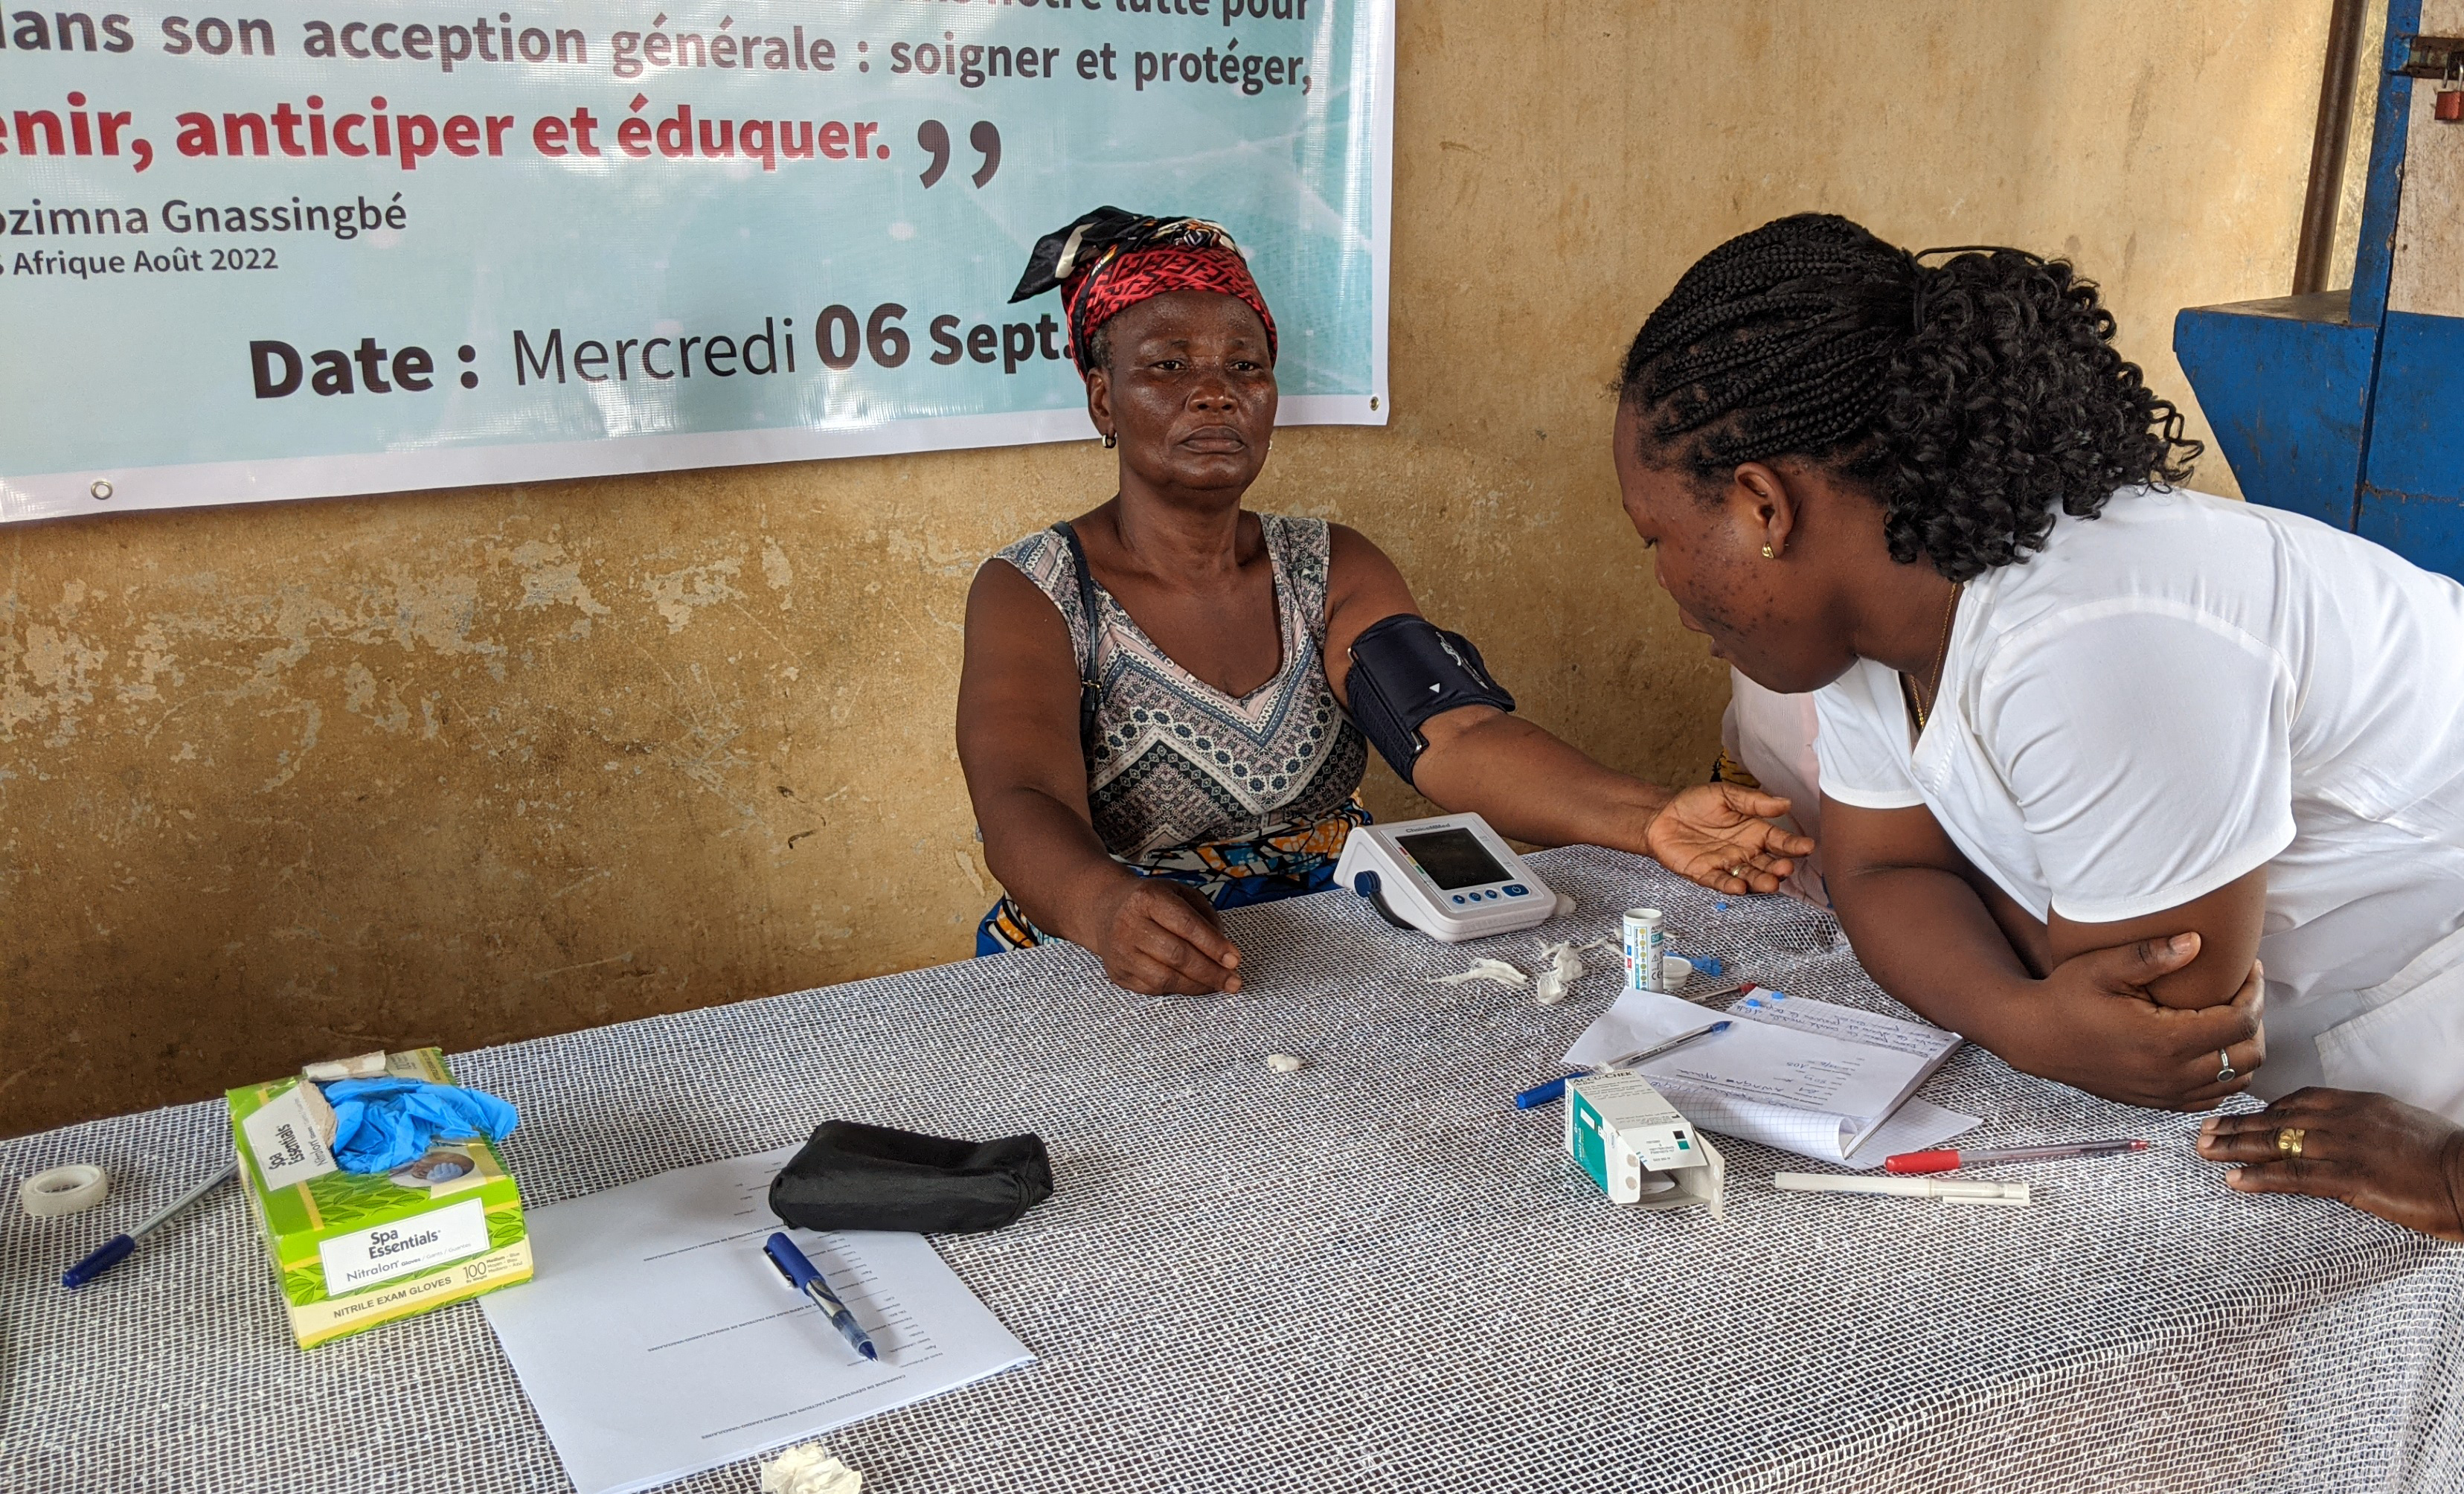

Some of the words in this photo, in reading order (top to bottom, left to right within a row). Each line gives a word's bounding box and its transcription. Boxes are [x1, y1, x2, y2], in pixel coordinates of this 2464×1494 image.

[0, 6, 133, 53] ans
[162, 16, 275, 55] son
[304, 13, 585, 72] acception
[612, 13, 835, 77] générale
[890, 31, 1060, 88] soigner
[1077, 43, 1117, 80] et
[1135, 37, 1309, 95] protéger,
[176, 95, 513, 170] anticiper
[533, 108, 600, 155] et
[617, 93, 890, 170] éduquer.
[0, 199, 148, 235] zimna
[162, 192, 405, 240] Gnassingbé
[13, 251, 124, 279] Afrique
[134, 247, 203, 272] Août
[211, 249, 277, 270] 2022
[250, 338, 433, 398] Date
[514, 317, 795, 385] Mercredi
[815, 303, 910, 368] 06
[927, 309, 1071, 376] Sept.
[269, 1152, 289, 1170] Spa
[275, 1123, 305, 1165] Essentials
[368, 1230, 439, 1260] Essentials
[370, 1229, 399, 1246] Spa
[347, 1260, 399, 1282] Nitralon
[401, 1257, 421, 1266] Gloves
[448, 1243, 472, 1253] Guantes
[463, 1261, 487, 1279] 100
[487, 1255, 505, 1263] Medium
[488, 1265, 508, 1274] Mediano
[512, 1261, 523, 1269] Azul
[333, 1299, 373, 1318] NITRILE
[377, 1289, 408, 1306] EXAM
[409, 1277, 452, 1295] GLOVES
